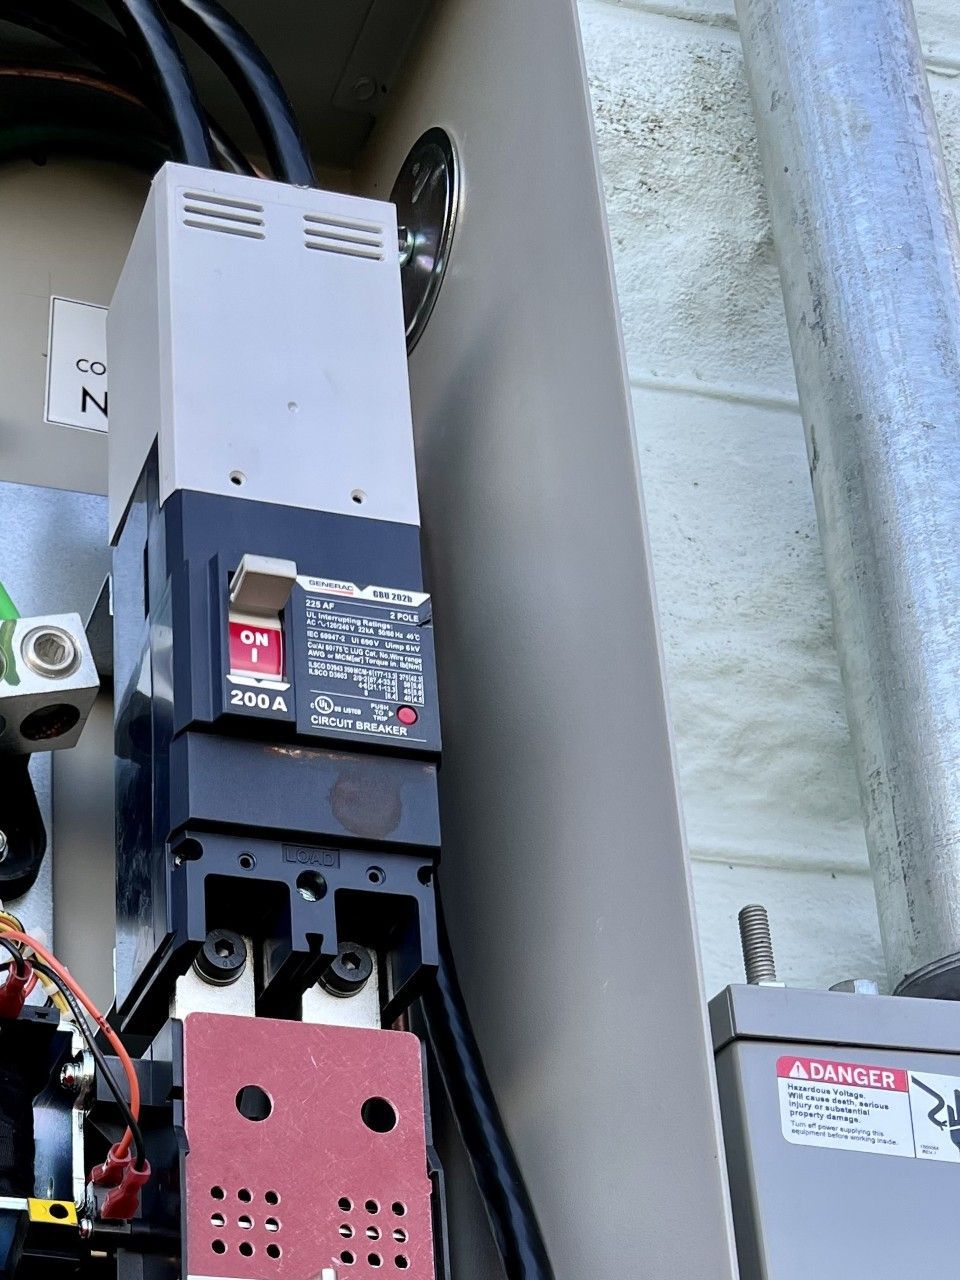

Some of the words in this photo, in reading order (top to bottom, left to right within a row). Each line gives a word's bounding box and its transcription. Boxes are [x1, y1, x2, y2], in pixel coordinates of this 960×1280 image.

[309, 580, 353, 591] GENERAC
[306, 599, 321, 609] 225
[322, 601, 335, 610] AF
[390, 612, 396, 620] 2
[397, 613, 419, 623] POLE
[318, 613, 361, 627] Interrupting
[240, 630, 269, 647] ON
[307, 630, 318, 638] IEC
[370, 703, 389, 711] PUSH
[310, 715, 353, 729] CIRCUIT
[356, 721, 408, 736] BREAKER
[285, 847, 335, 867] LOAD
[810, 1062, 896, 1089] DANGER
[788, 1083, 831, 1095] Hazardous
[832, 1088, 866, 1100] Voltage.
[788, 1092, 803, 1100] Will
[806, 1095, 830, 1103] cause
[859, 1101, 890, 1110] serious
[790, 1110, 824, 1120] property
[827, 1112, 861, 1123] damage.
[825, 1105, 870, 1116] substantial
[791, 1120, 806, 1129] Turn
[818, 1124, 838, 1133] power
[840, 1127, 871, 1136] supplying
[792, 1128, 826, 1138] equipment
[827, 1131, 849, 1140] before
[850, 1135, 876, 1144] working
